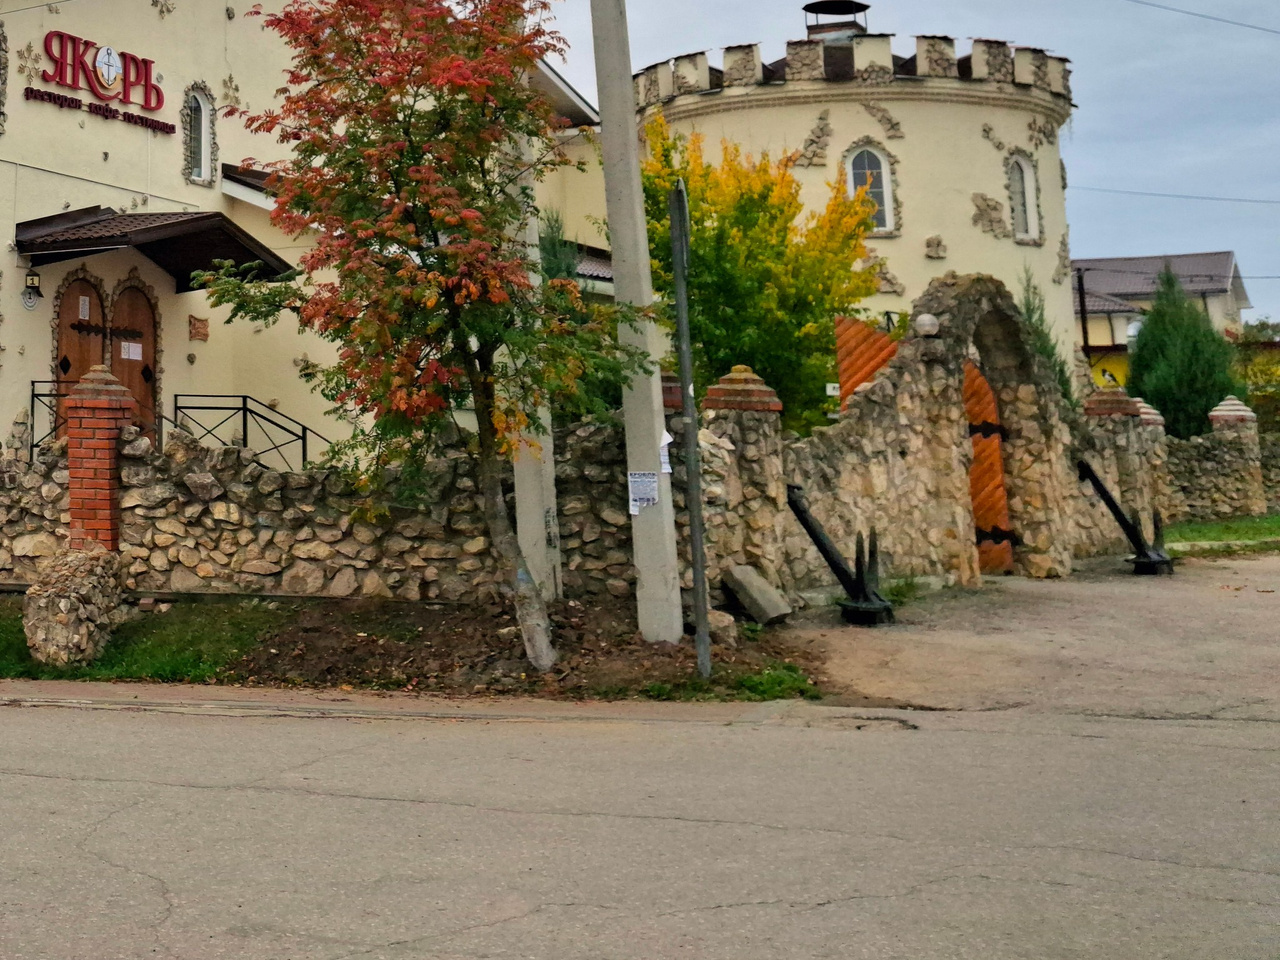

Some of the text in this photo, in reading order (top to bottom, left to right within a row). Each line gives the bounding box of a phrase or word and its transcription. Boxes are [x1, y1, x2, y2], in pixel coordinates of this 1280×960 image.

[24, 86, 177, 135] ресторан кафе гостиница
